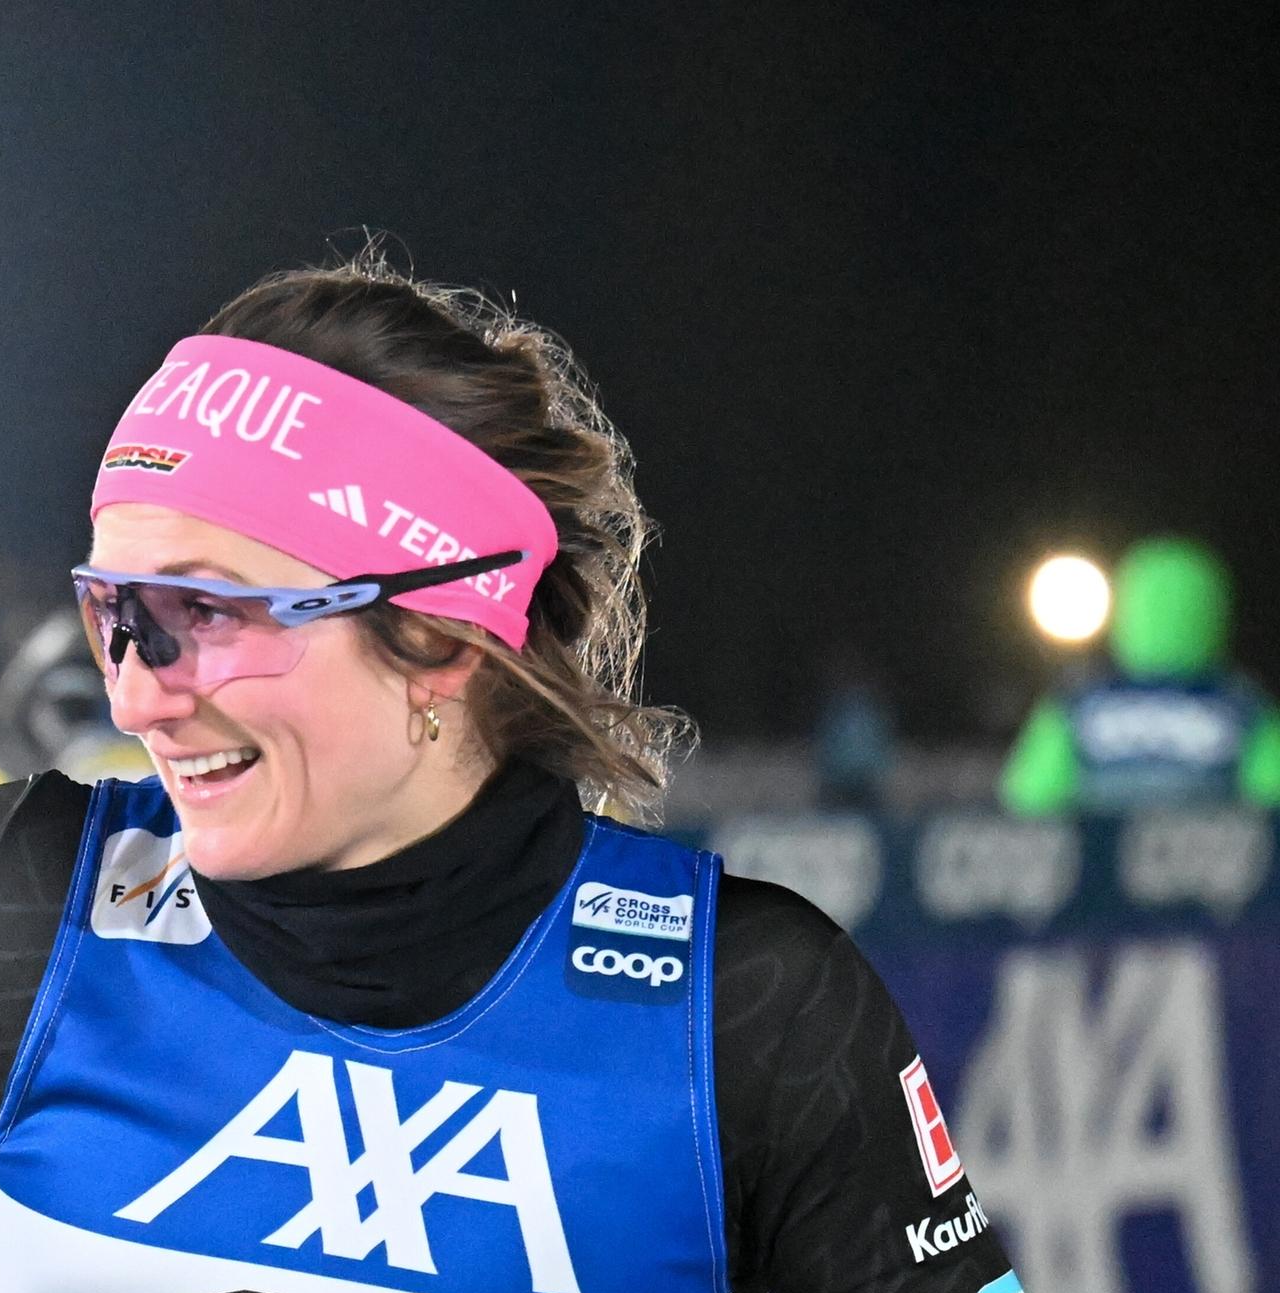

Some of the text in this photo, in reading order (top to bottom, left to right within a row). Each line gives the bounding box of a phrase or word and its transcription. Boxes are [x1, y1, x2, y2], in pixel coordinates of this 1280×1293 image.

[616, 897, 671, 914] CROSS
[614, 907, 688, 926] COUNTRY
[614, 918, 683, 932] WORLD CUP
[571, 945, 684, 987] coop
